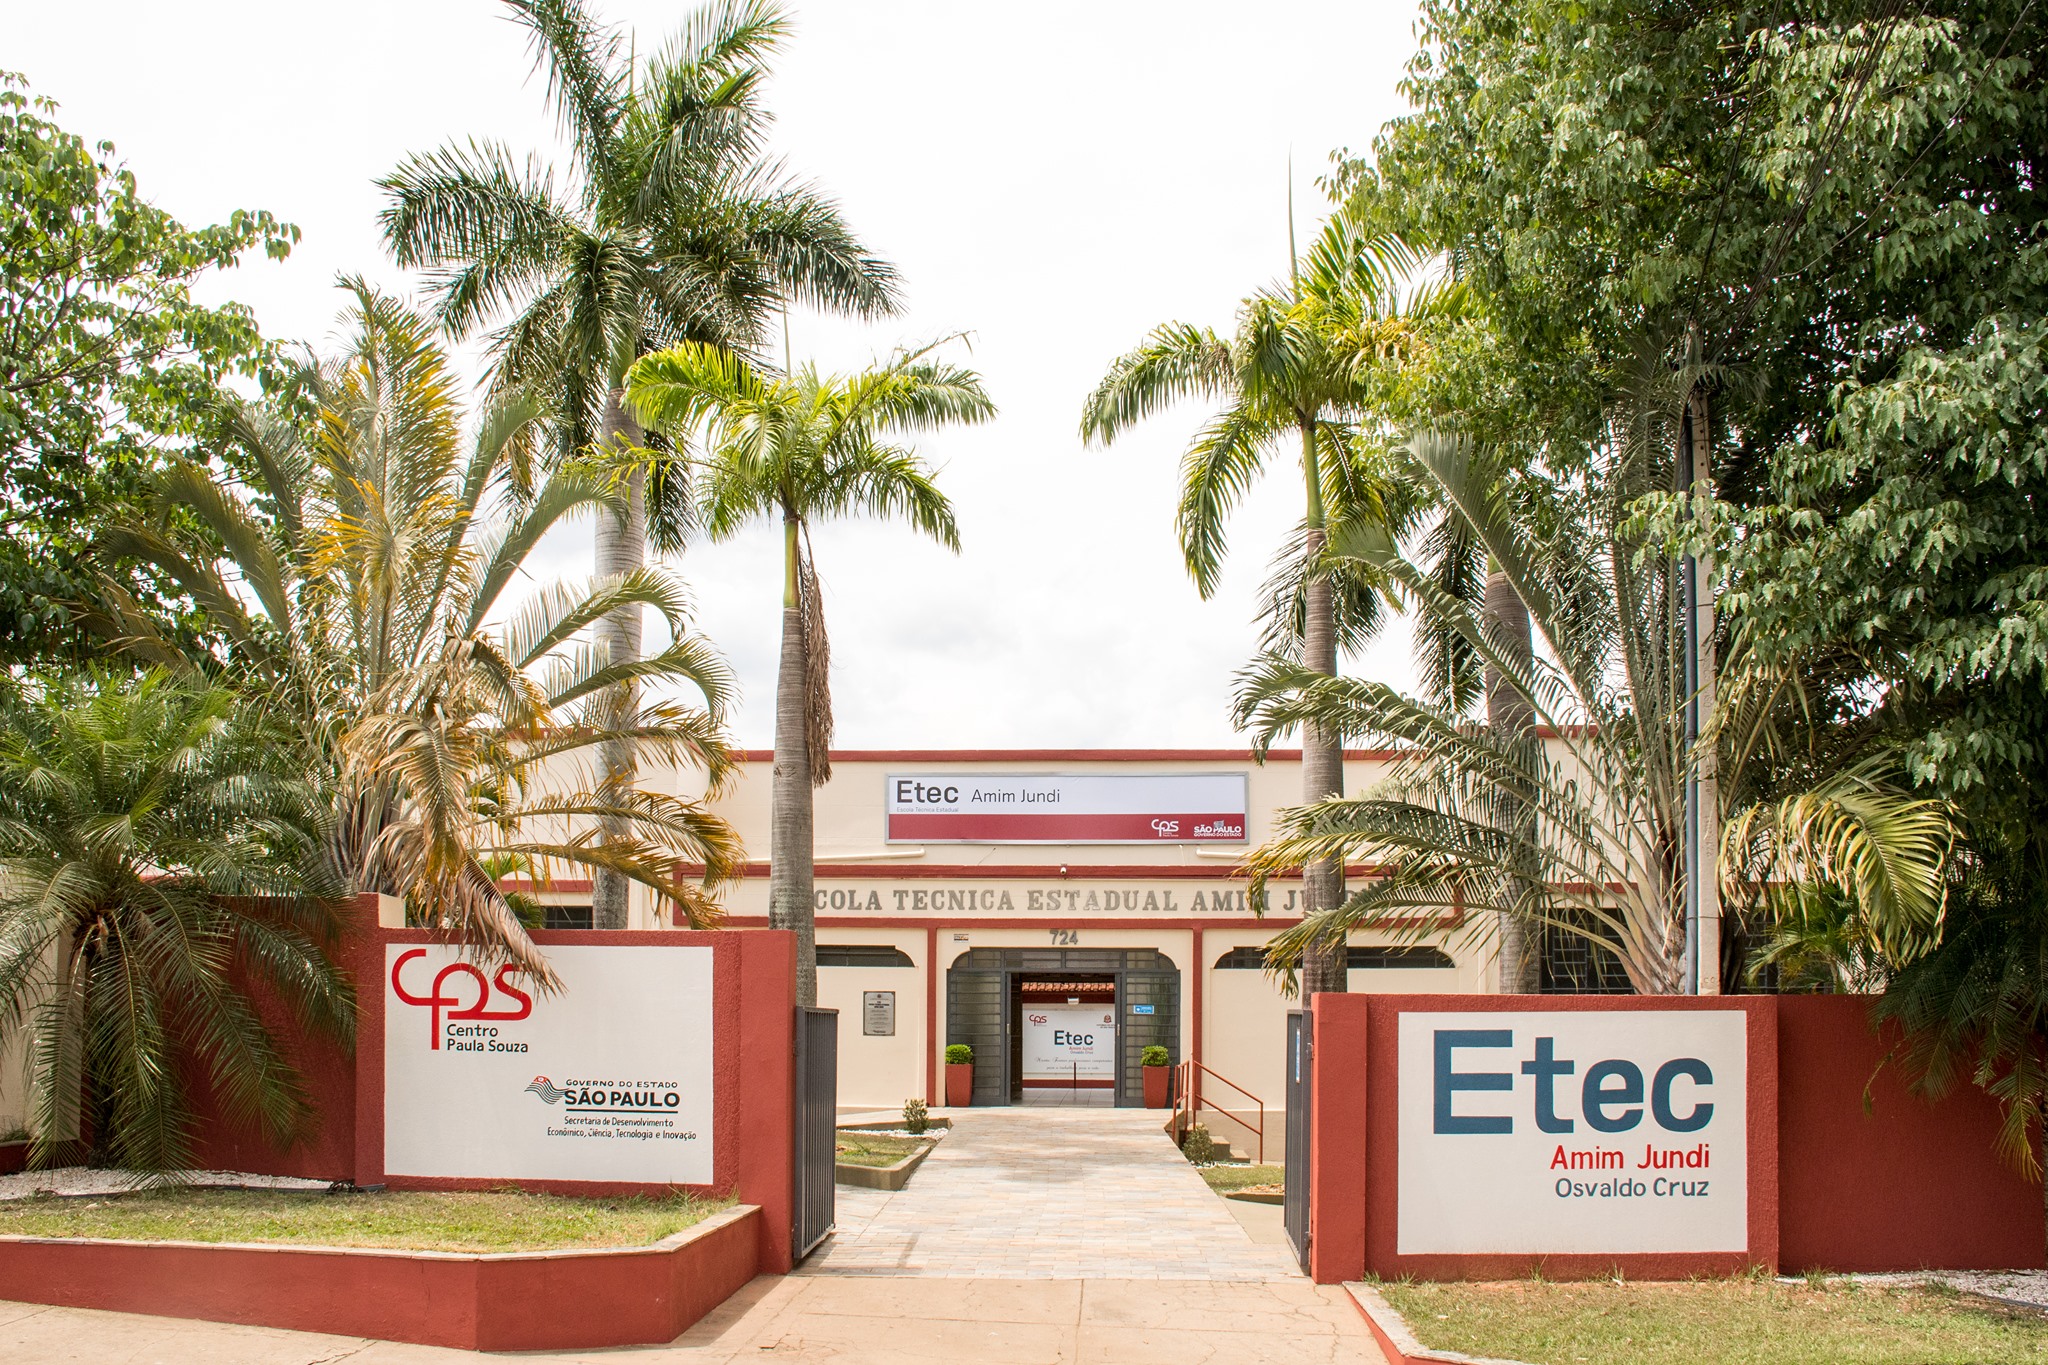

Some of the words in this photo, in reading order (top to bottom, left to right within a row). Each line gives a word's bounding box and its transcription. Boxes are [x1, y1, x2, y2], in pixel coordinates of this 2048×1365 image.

[897, 780, 959, 803] Etec
[971, 789, 1015, 803] Amim
[1021, 789, 1060, 803] Jundi
[1194, 822, 1212, 833] SÃO
[1213, 825, 1242, 833] PAULO
[814, 889, 882, 911] COLA
[893, 889, 1015, 911] TECNICA
[1027, 889, 1178, 911] ESTADUAL
[1050, 930, 1078, 945] 724
[446, 1024, 499, 1037] Centro
[1054, 1030, 1094, 1046] Etec
[447, 1038, 484, 1051] Paula
[488, 1040, 528, 1053] Souza
[566, 1079, 614, 1087] GOVERNO
[637, 1081, 678, 1089] ESTADO
[1433, 1029, 1714, 1135] Etec
[564, 1087, 607, 1106] SÃO
[610, 1091, 681, 1108] PAULO
[564, 1115, 601, 1126] Secretaria
[602, 1116, 611, 1126] de
[611, 1117, 674, 1128] Desenvolvimento
[616, 1128, 653, 1140] Tecnologia
[663, 1130, 697, 1141] Inovação
[1550, 1145, 1624, 1170] Amim
[1637, 1144, 1710, 1169] Jundi
[1555, 1177, 1647, 1198] Osvaldo
[1653, 1177, 1709, 1197] Cruz
